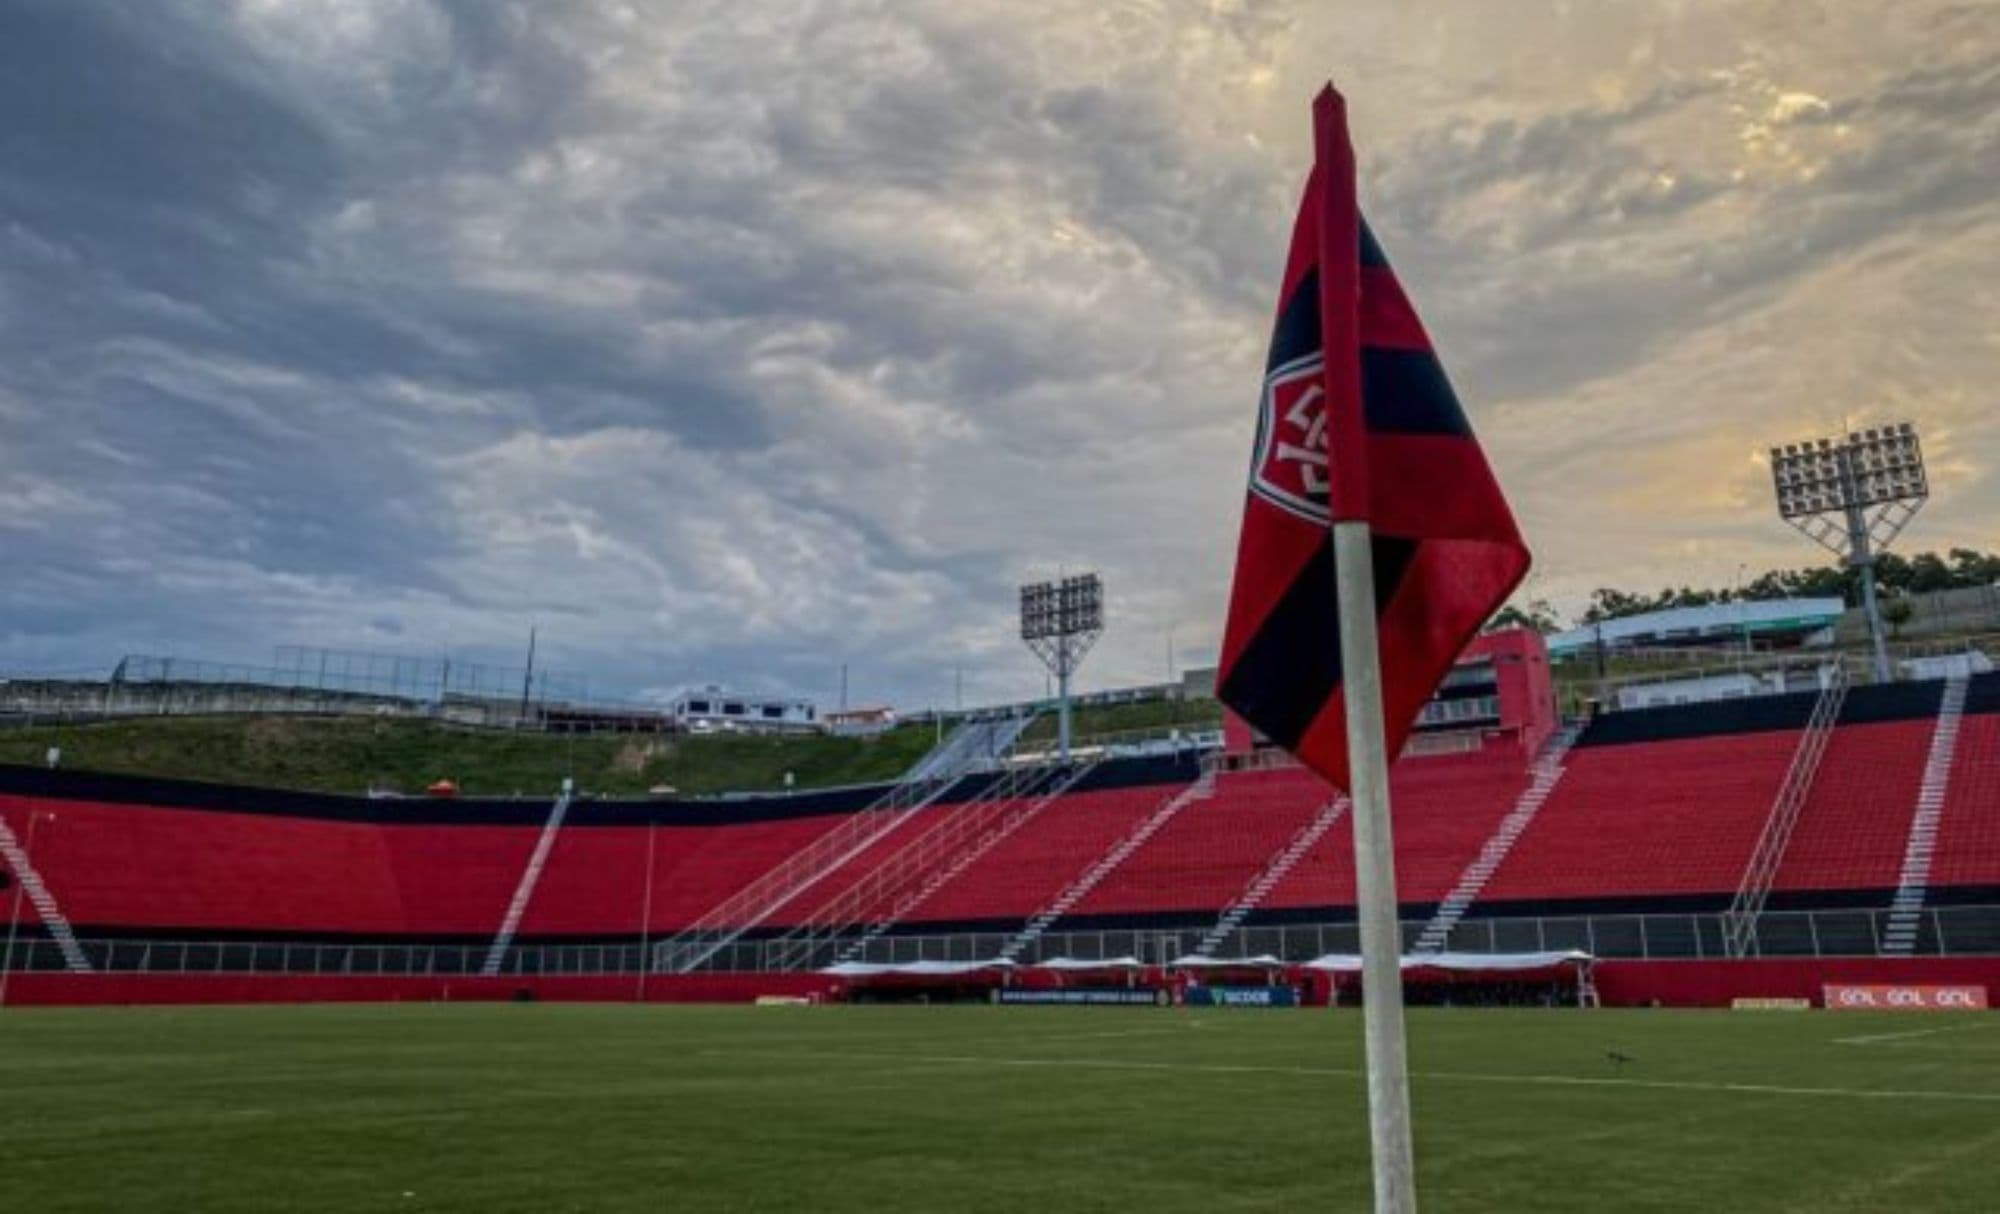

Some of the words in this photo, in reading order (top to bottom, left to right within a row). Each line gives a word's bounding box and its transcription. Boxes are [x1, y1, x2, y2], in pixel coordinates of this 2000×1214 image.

[1840, 988, 1876, 1006] GOL
[1887, 988, 1925, 1006] GOL
[1936, 989, 1976, 1007] GOL
